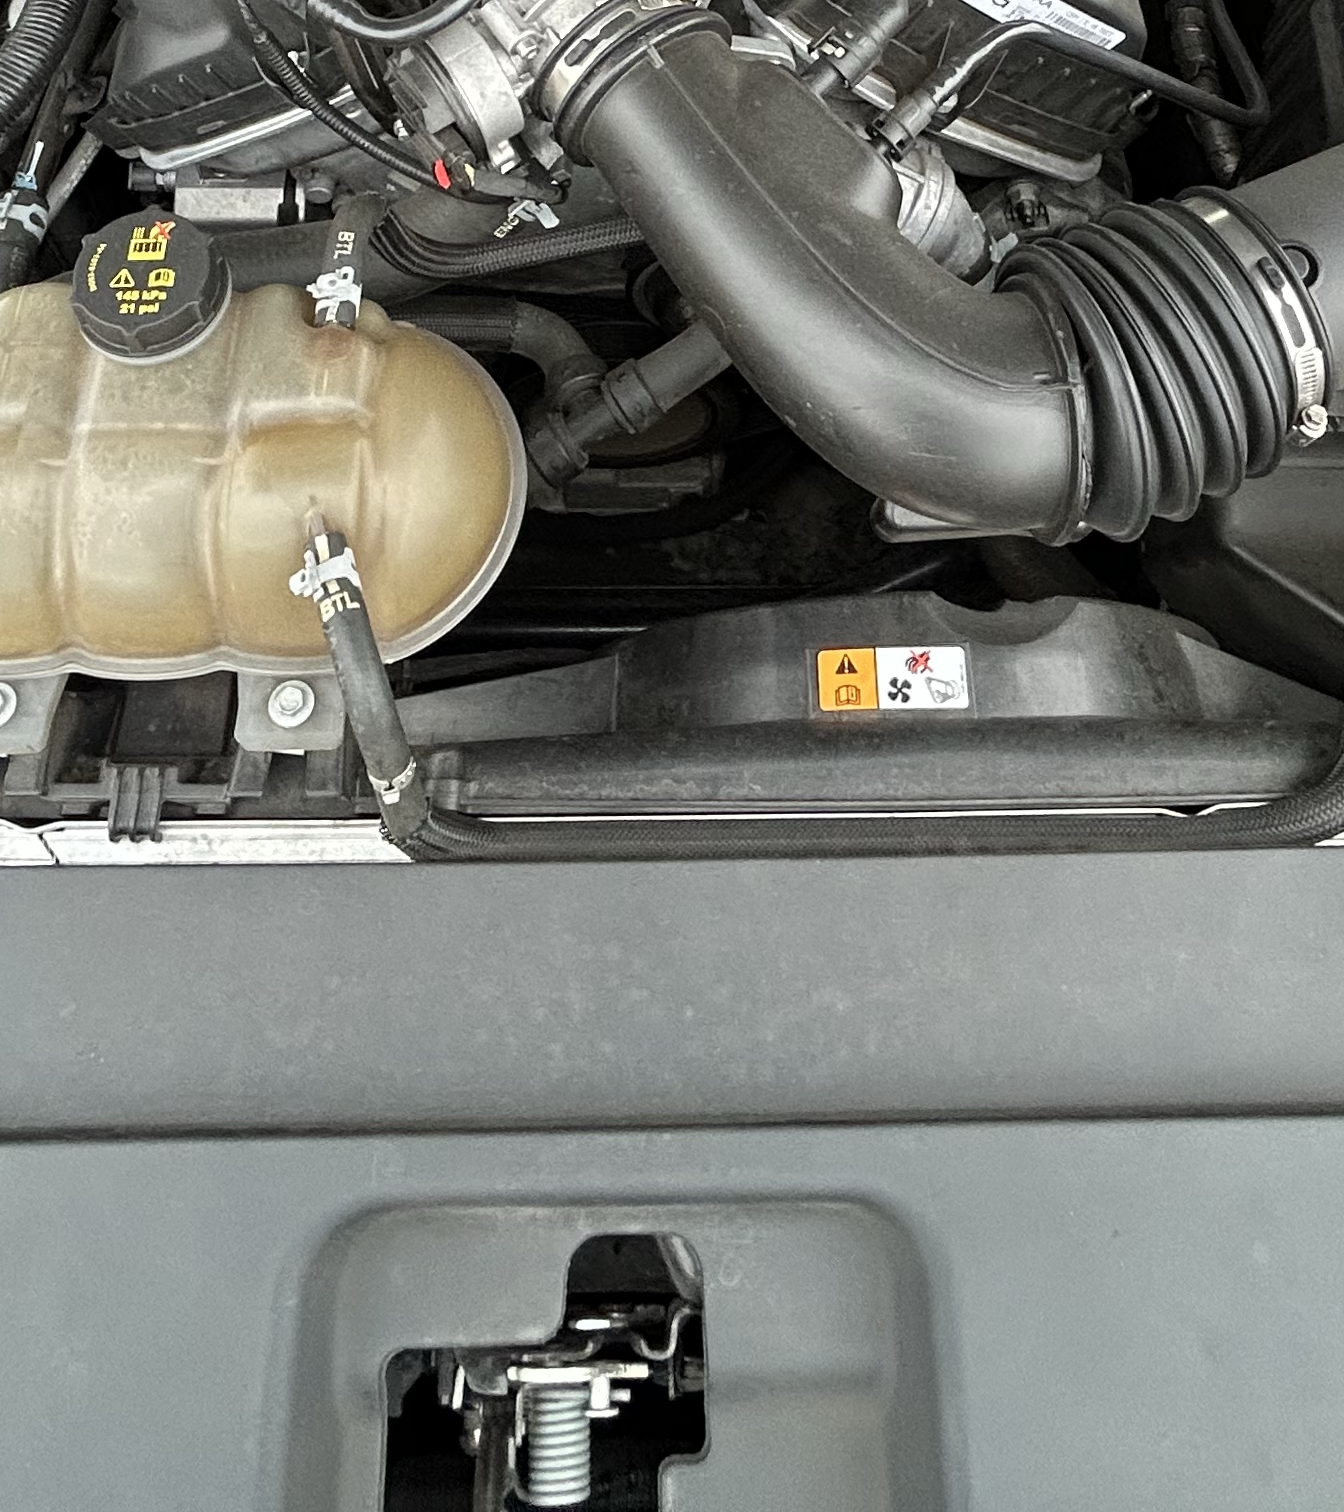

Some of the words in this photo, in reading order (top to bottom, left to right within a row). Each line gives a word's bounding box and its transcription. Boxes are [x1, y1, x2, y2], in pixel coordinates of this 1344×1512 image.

[493, 215, 520, 239] ENG
[333, 230, 356, 260] BTL
[141, 289, 167, 301] kPa
[118, 302, 136, 314] 21
[138, 301, 160, 316] psi
[319, 590, 361, 623] BTL
